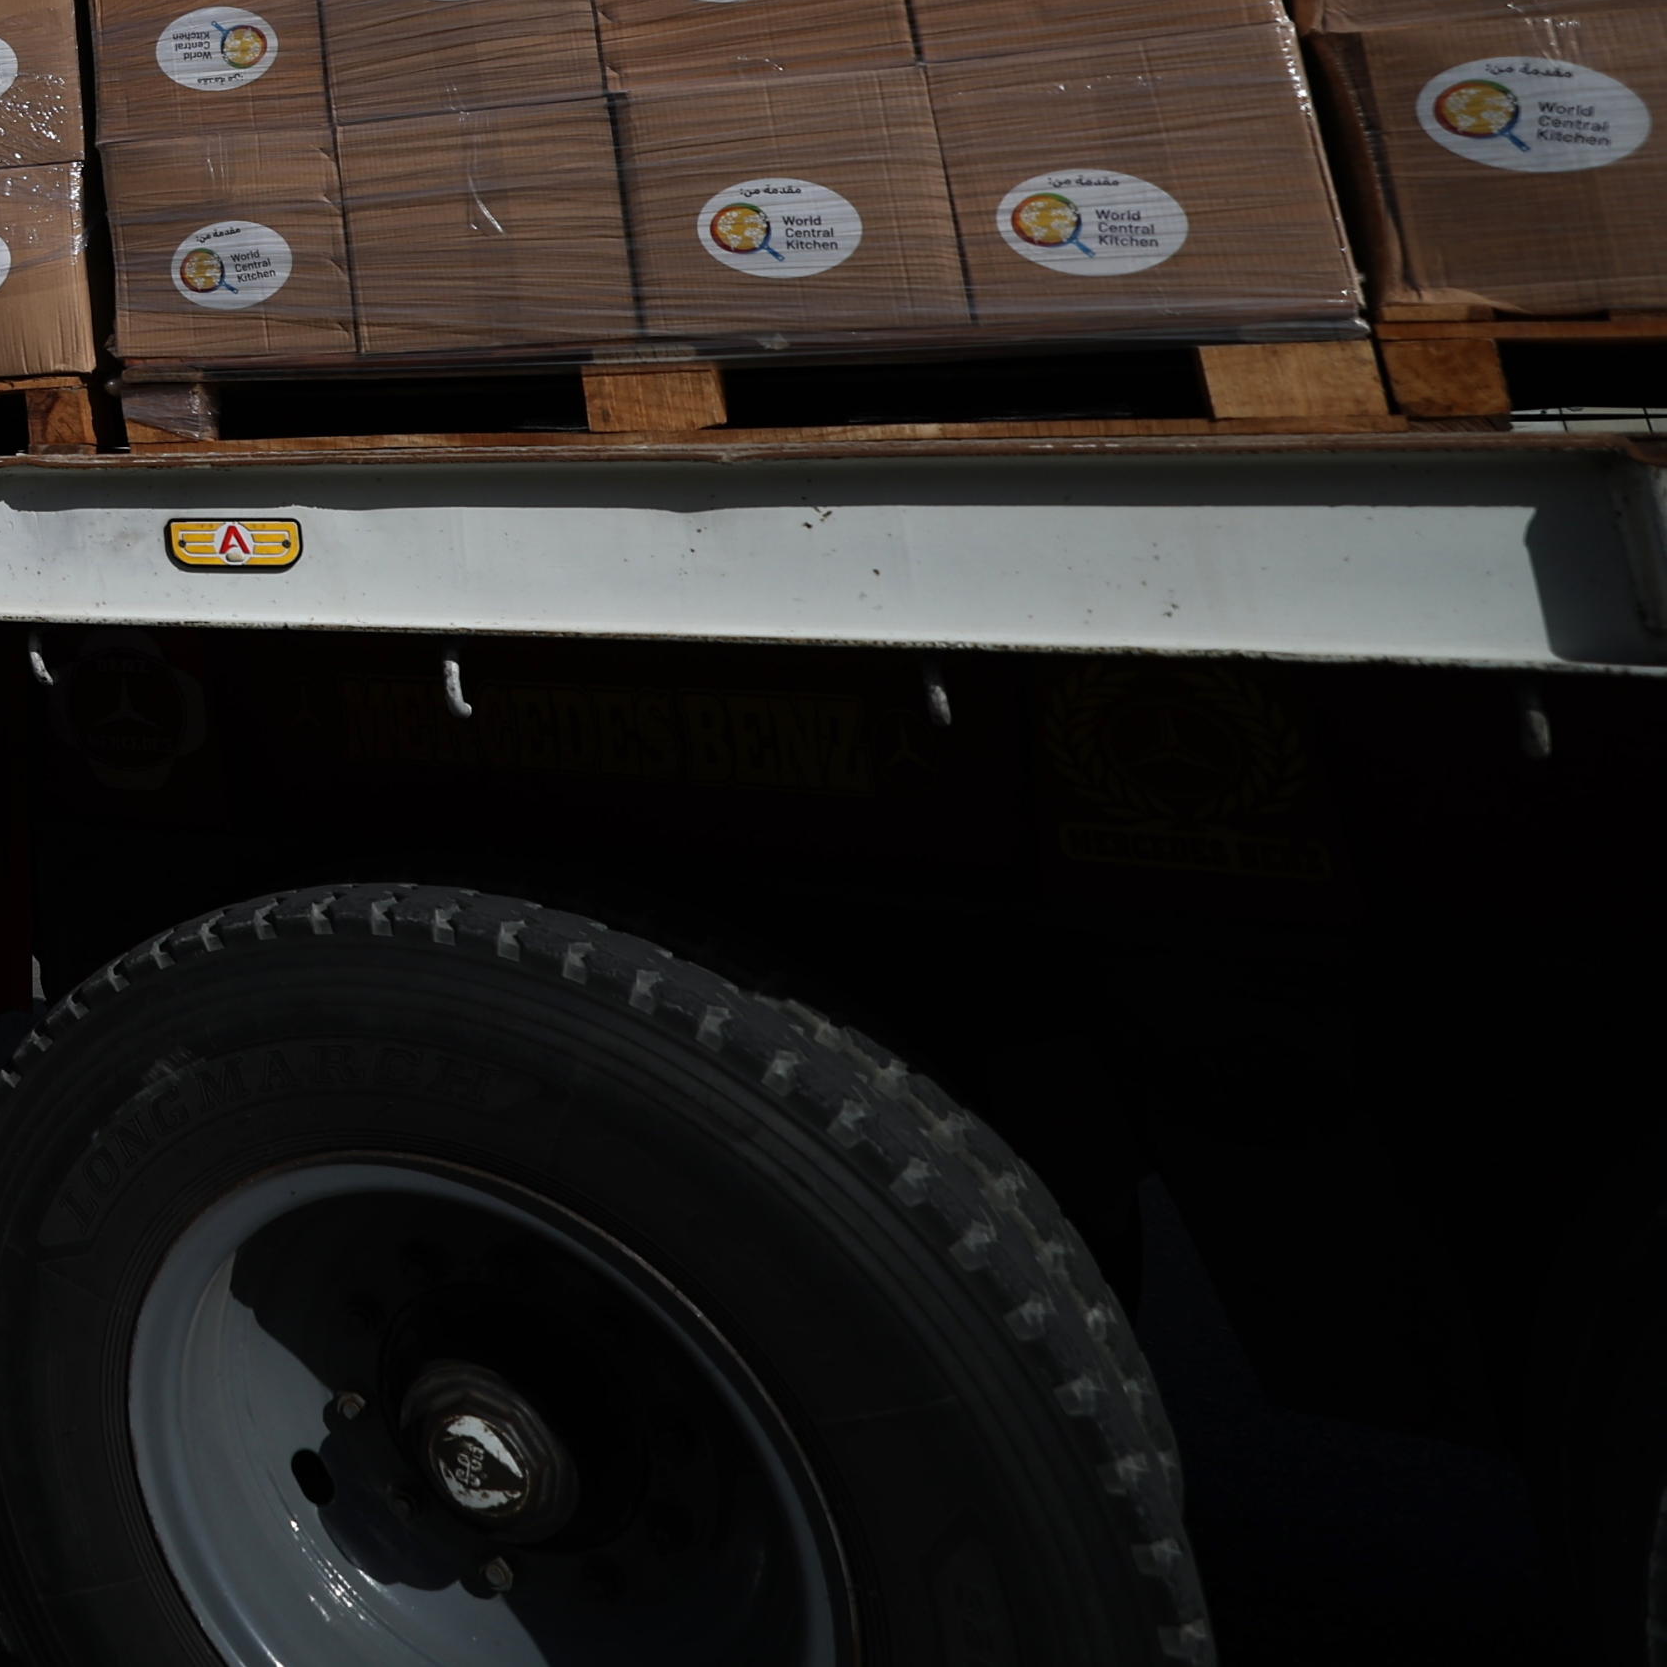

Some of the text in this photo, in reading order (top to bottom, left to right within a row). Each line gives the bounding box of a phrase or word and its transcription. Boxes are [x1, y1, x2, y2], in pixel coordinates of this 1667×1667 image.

[1537, 101, 1595, 117] World
[1537, 115, 1610, 132] Central
[1536, 130, 1611, 147] Kitchen
[782, 215, 822, 226] World
[1095, 209, 1141, 222] World
[785, 227, 835, 239] Central
[1097, 222, 1155, 235] Central
[786, 239, 839, 250] Kitchen
[1098, 235, 1159, 247] Kitchen
[230, 250, 261, 263] World
[235, 258, 271, 272] Central
[237, 268, 276, 282] Kitchen
[219, 525, 251, 554] A
[59, 1044, 500, 1234] LONG MARCH
